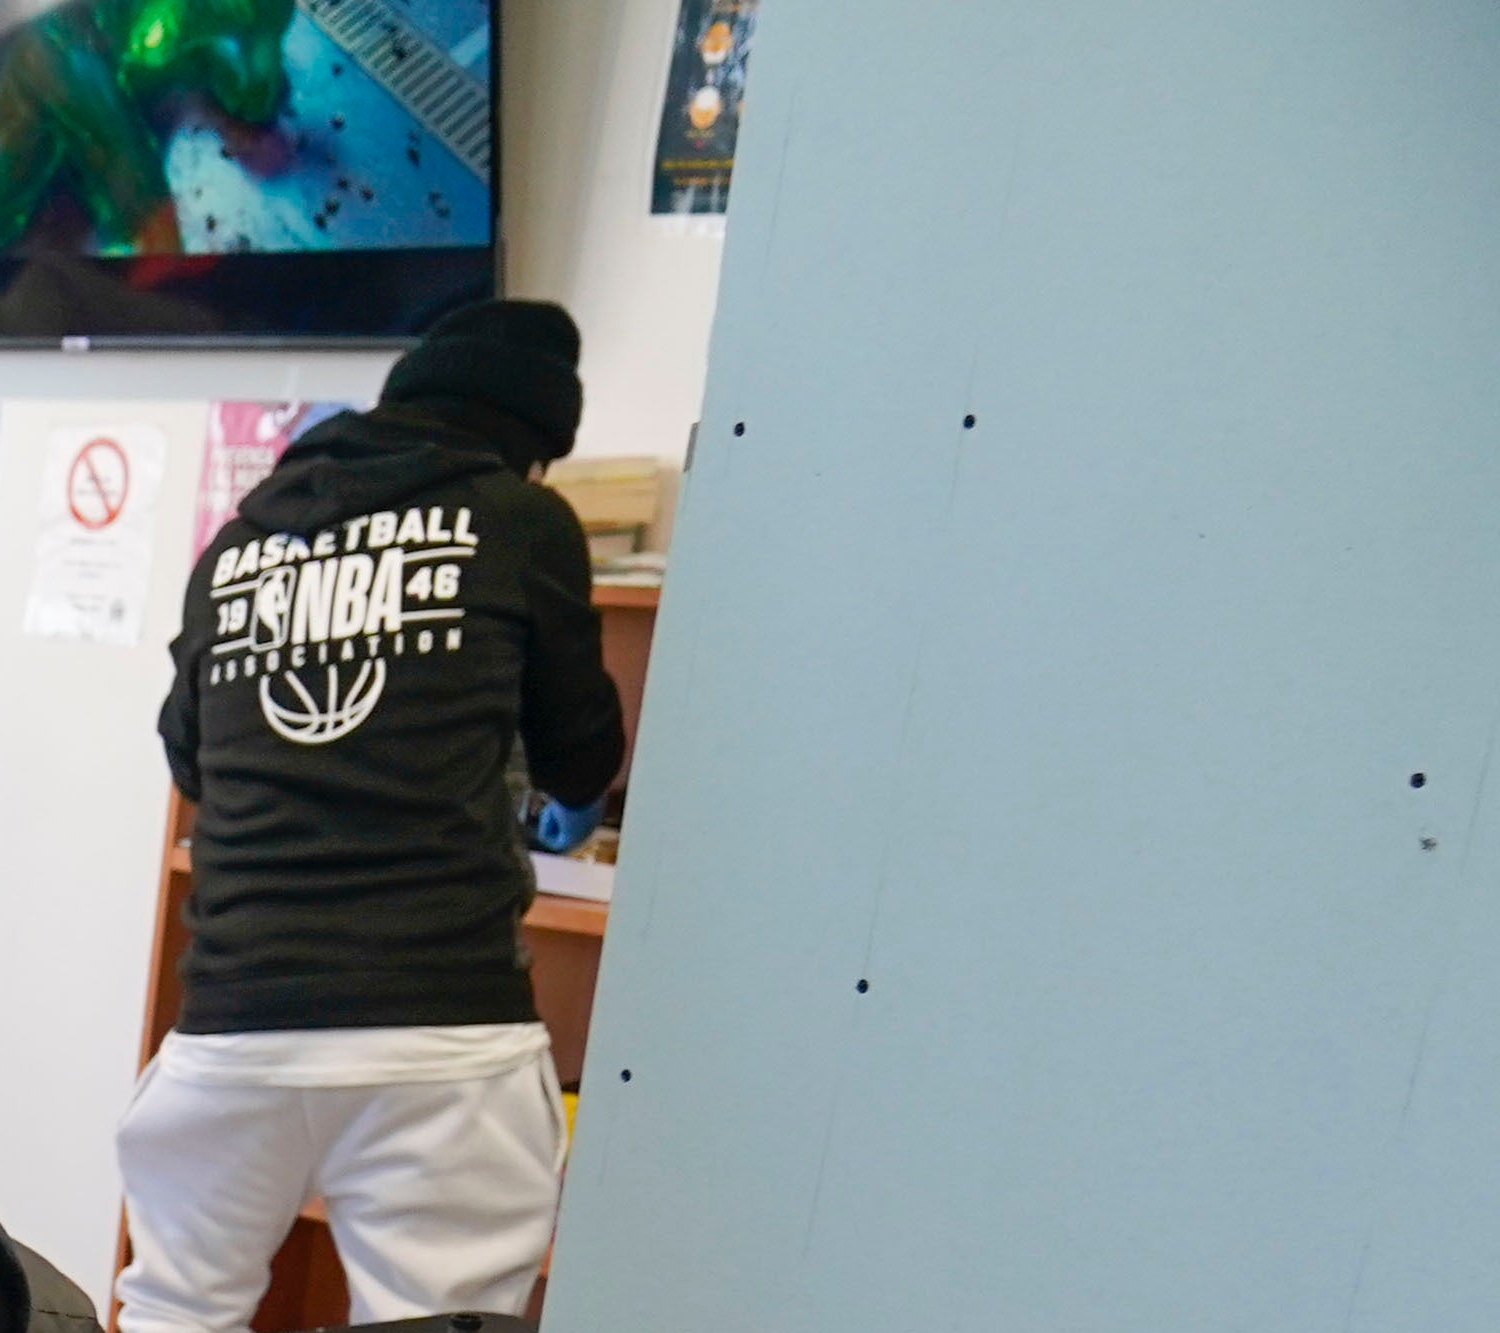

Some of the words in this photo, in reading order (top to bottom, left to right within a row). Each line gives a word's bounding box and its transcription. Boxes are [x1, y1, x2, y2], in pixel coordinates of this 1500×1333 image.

[212, 505, 480, 588] BASKETBALL
[216, 598, 248, 636] 19
[290, 546, 406, 645] NBA
[405, 563, 462, 601] 46
[209, 626, 464, 686] ASSOCIATION
